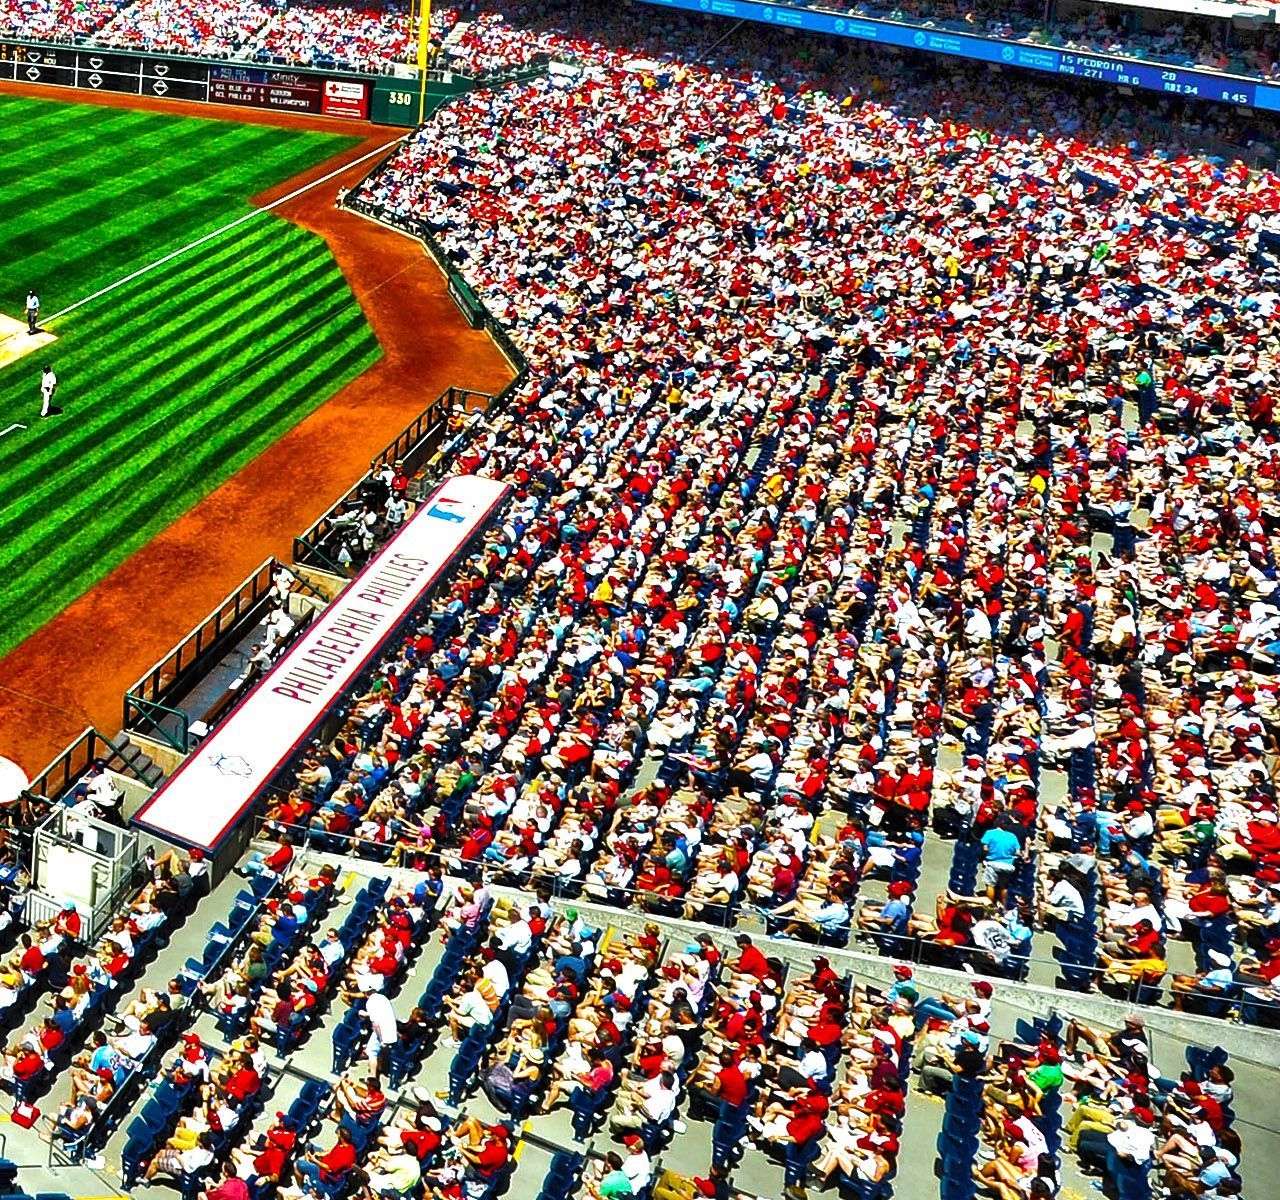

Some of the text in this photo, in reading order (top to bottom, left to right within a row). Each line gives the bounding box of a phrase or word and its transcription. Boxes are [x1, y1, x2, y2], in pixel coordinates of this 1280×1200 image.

[1061, 56, 1124, 72] 15 PEDROIA
[272, 72, 300, 82] xfinity
[389, 91, 411, 106] 330
[1184, 85, 1198, 95] 34
[1222, 92, 1229, 100] R
[1231, 94, 1247, 104] 45
[271, 553, 429, 704] PHILADELPHIA PHILLIES
